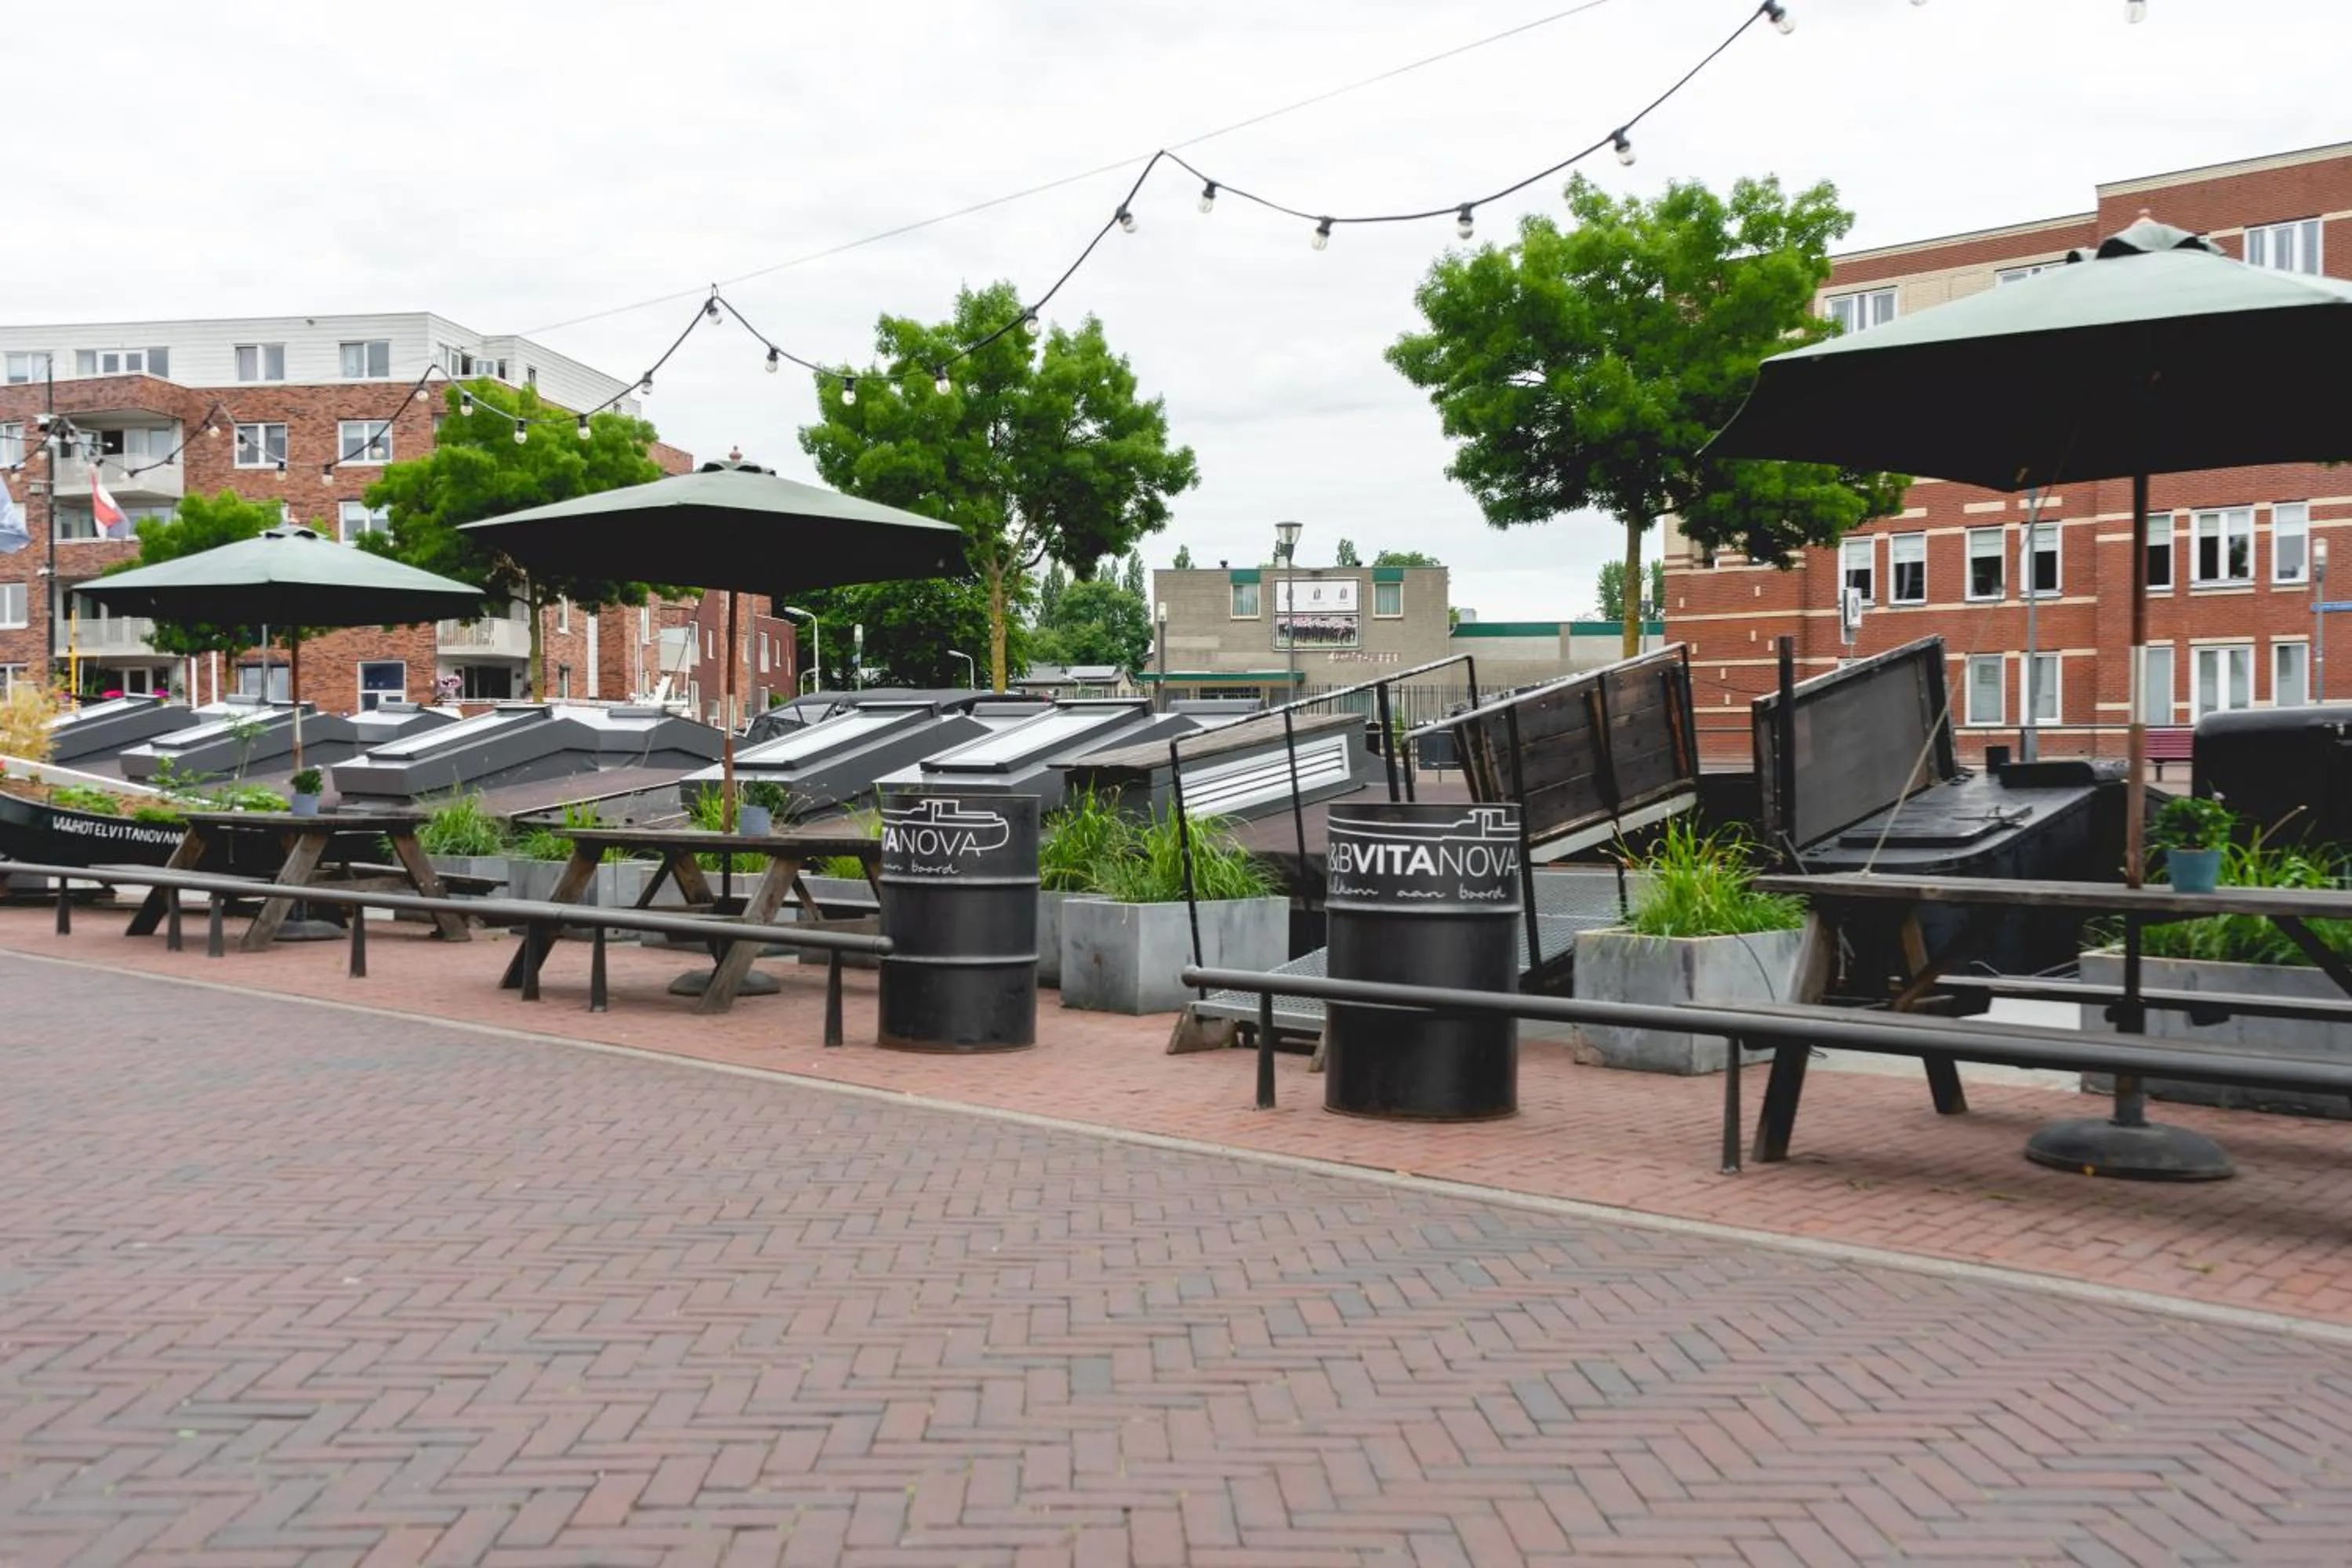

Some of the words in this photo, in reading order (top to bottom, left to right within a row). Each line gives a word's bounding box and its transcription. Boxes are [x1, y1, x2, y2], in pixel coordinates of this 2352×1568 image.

[912, 859, 959, 874] boord
[1396, 890, 1446, 899] aan
[1459, 882, 1506, 899] boord
